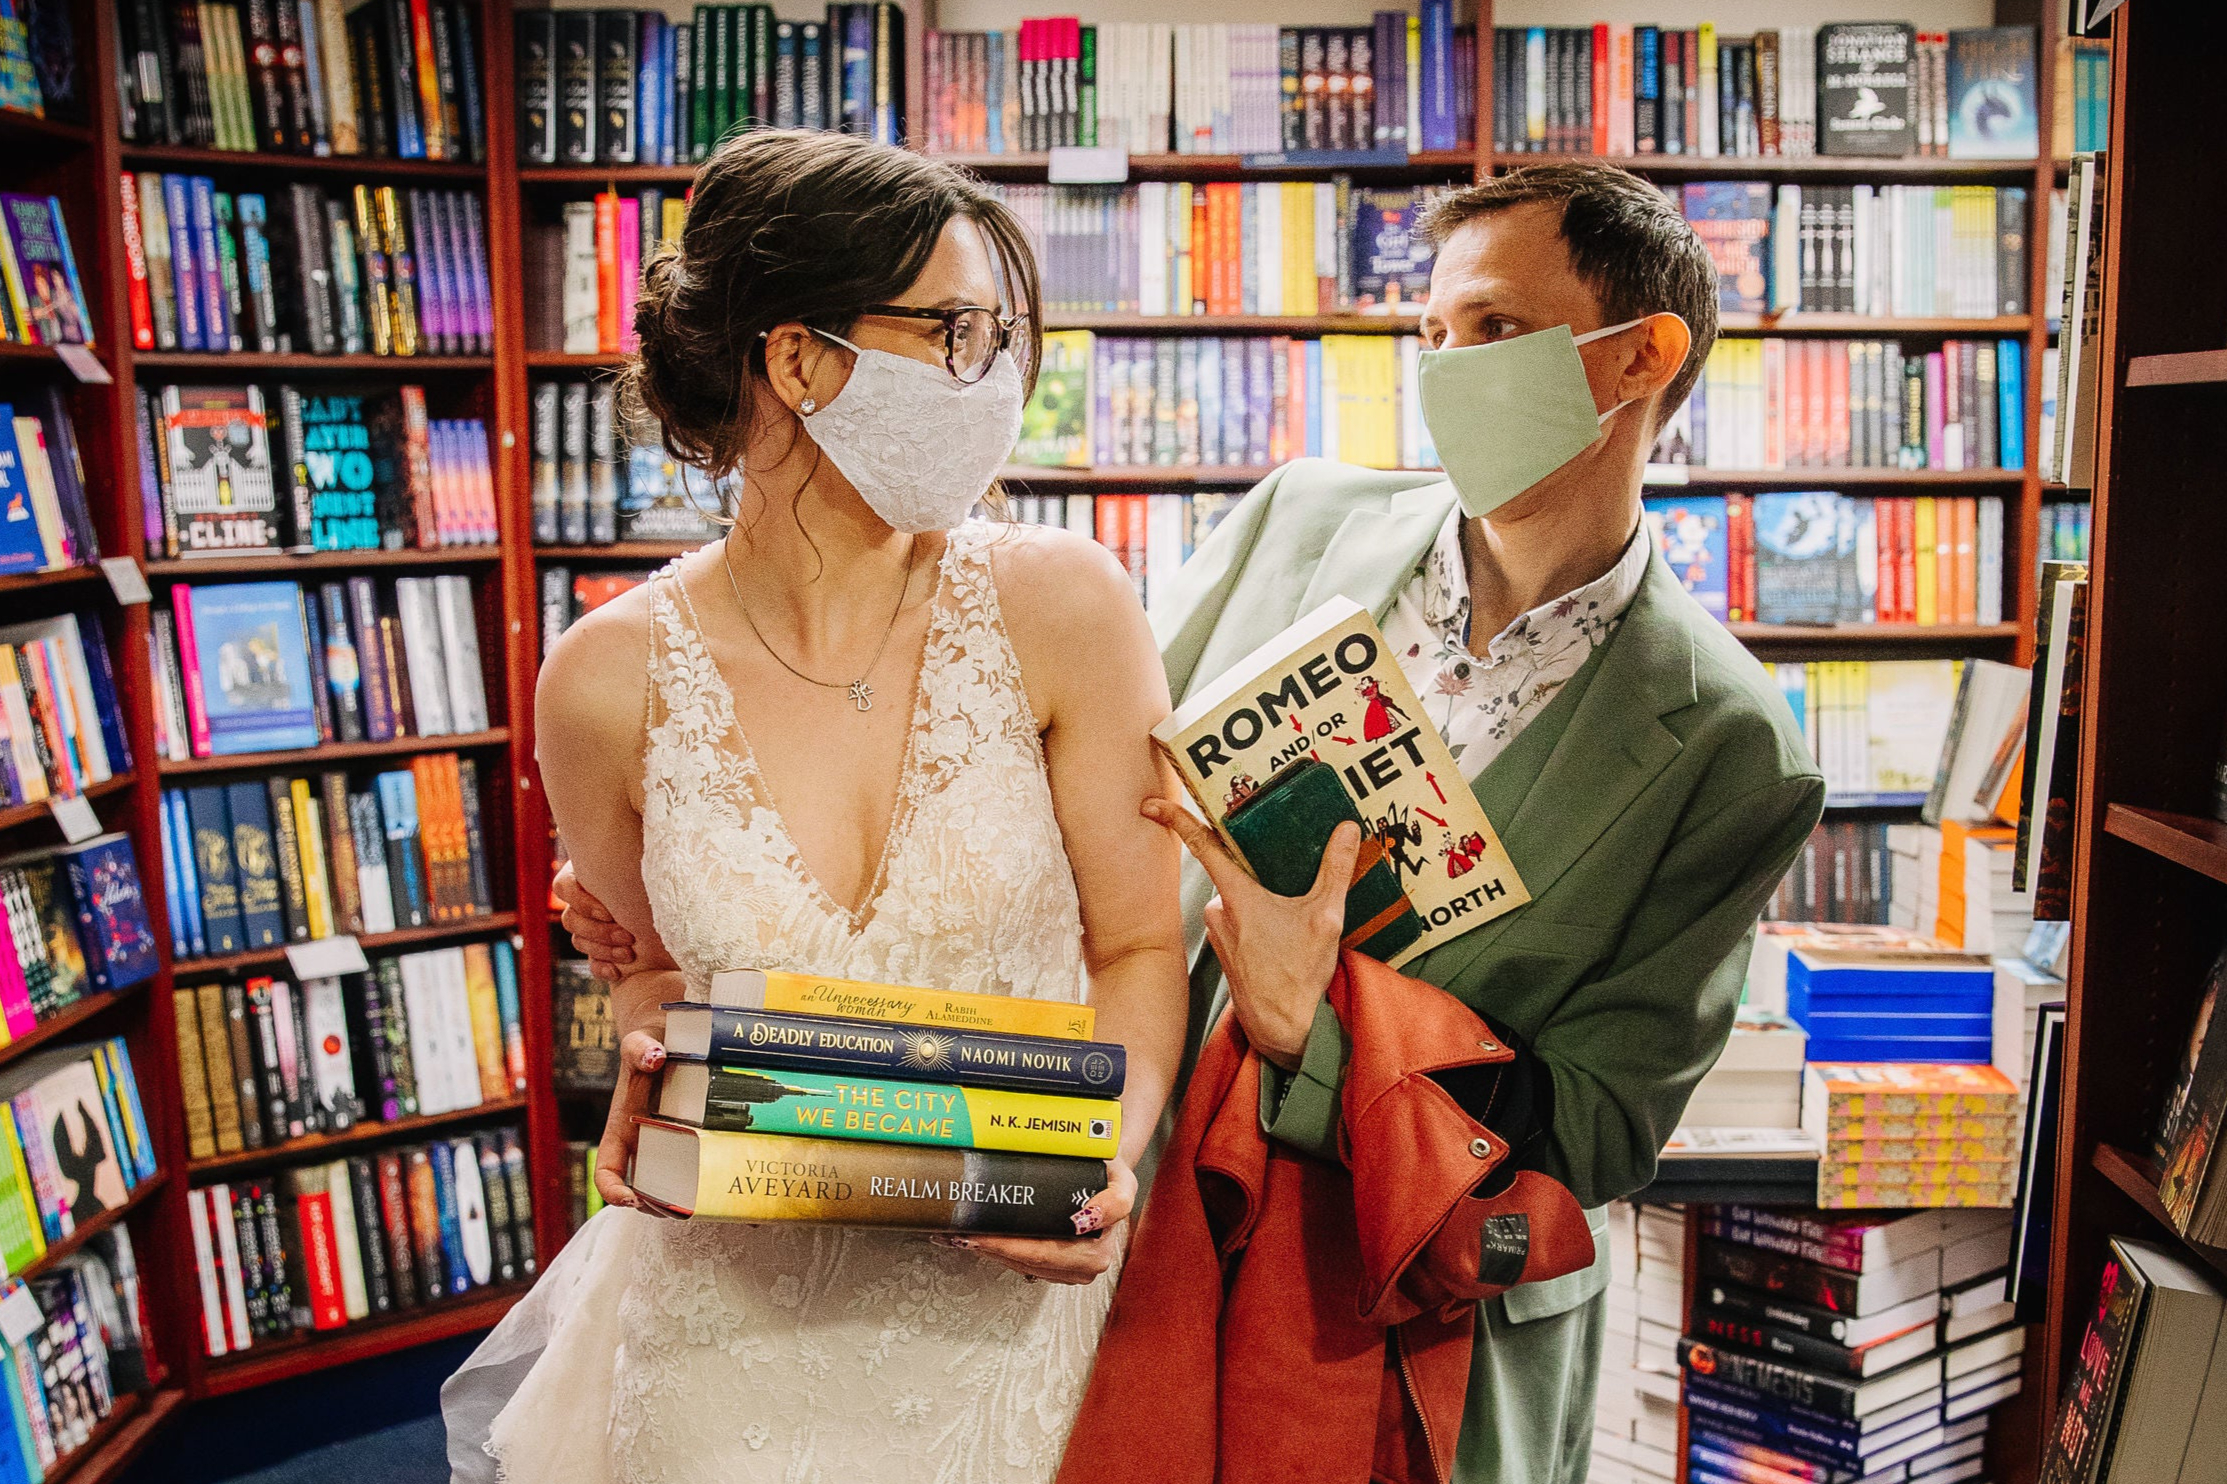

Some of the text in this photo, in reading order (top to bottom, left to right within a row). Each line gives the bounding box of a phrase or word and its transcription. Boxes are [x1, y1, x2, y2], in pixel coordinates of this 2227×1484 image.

[304, 450, 375, 491] WO
[189, 519, 268, 548] CLINE
[1185, 632, 1378, 780] ROMEO
[1269, 711, 1349, 773] AND/OR
[1344, 726, 1427, 801] IET
[800, 993, 815, 1002] an
[813, 985, 917, 1018] Unnecessary
[836, 1003, 887, 1018] woman
[733, 1022, 744, 1039] A
[819, 1032, 894, 1054] EDUCATION
[960, 1046, 1016, 1067] NAOMI
[1021, 1051, 1073, 1073] NOVIK
[1089, 1059, 1098, 1078] DEL
[1098, 1057, 1106, 1078] REY
[834, 1083, 956, 1113] THE CITY
[795, 1105, 956, 1139] WE BECAME
[989, 1114, 1082, 1134] N. K. JEMISIN
[745, 1159, 839, 1179] VICTORIA
[727, 1174, 1036, 1207] AVEYARD REALM BREAKER
[2080, 1320, 2110, 1393] LOVE
[1731, 1353, 1814, 1406] NEMESIS
[2060, 1399, 2090, 1472] NOT
